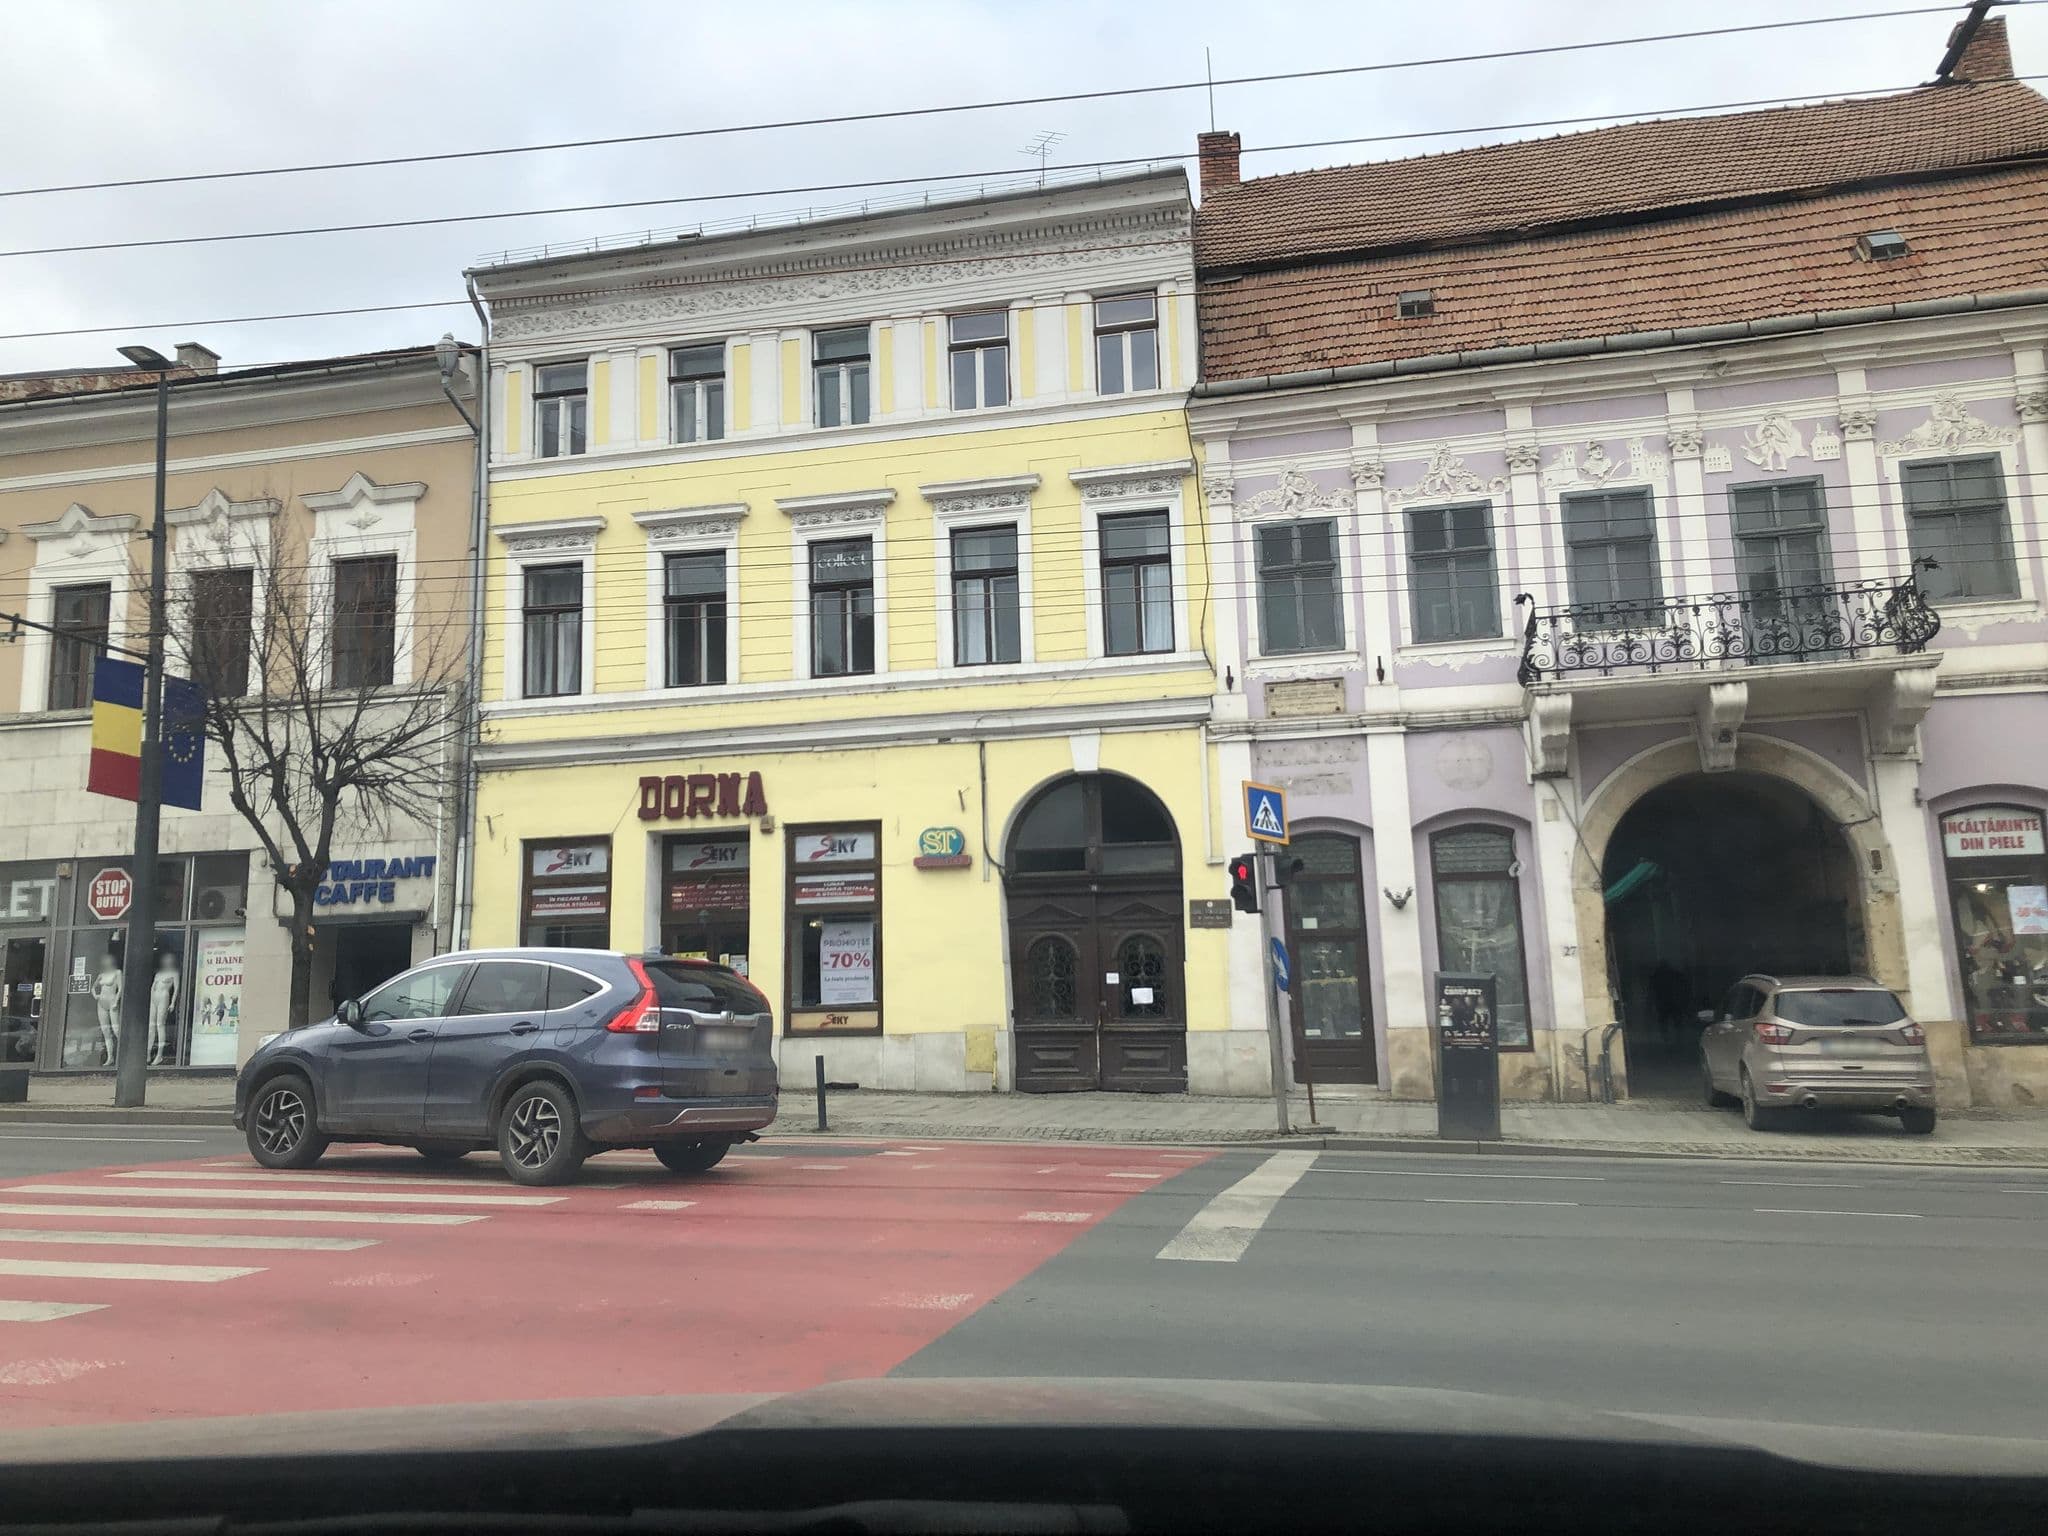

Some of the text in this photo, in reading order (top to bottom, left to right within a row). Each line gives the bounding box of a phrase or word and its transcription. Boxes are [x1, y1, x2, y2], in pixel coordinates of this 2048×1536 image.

[638, 771, 767, 821] DORNA
[923, 830, 957, 854] ST
[1961, 837, 1984, 850] DIN
[1988, 836, 2025, 849] PIELE
[96, 880, 127, 896] STOP
[314, 881, 396, 906] CAFFE
[96, 895, 125, 909] BUTIK
[823, 952, 871, 969] -70%
